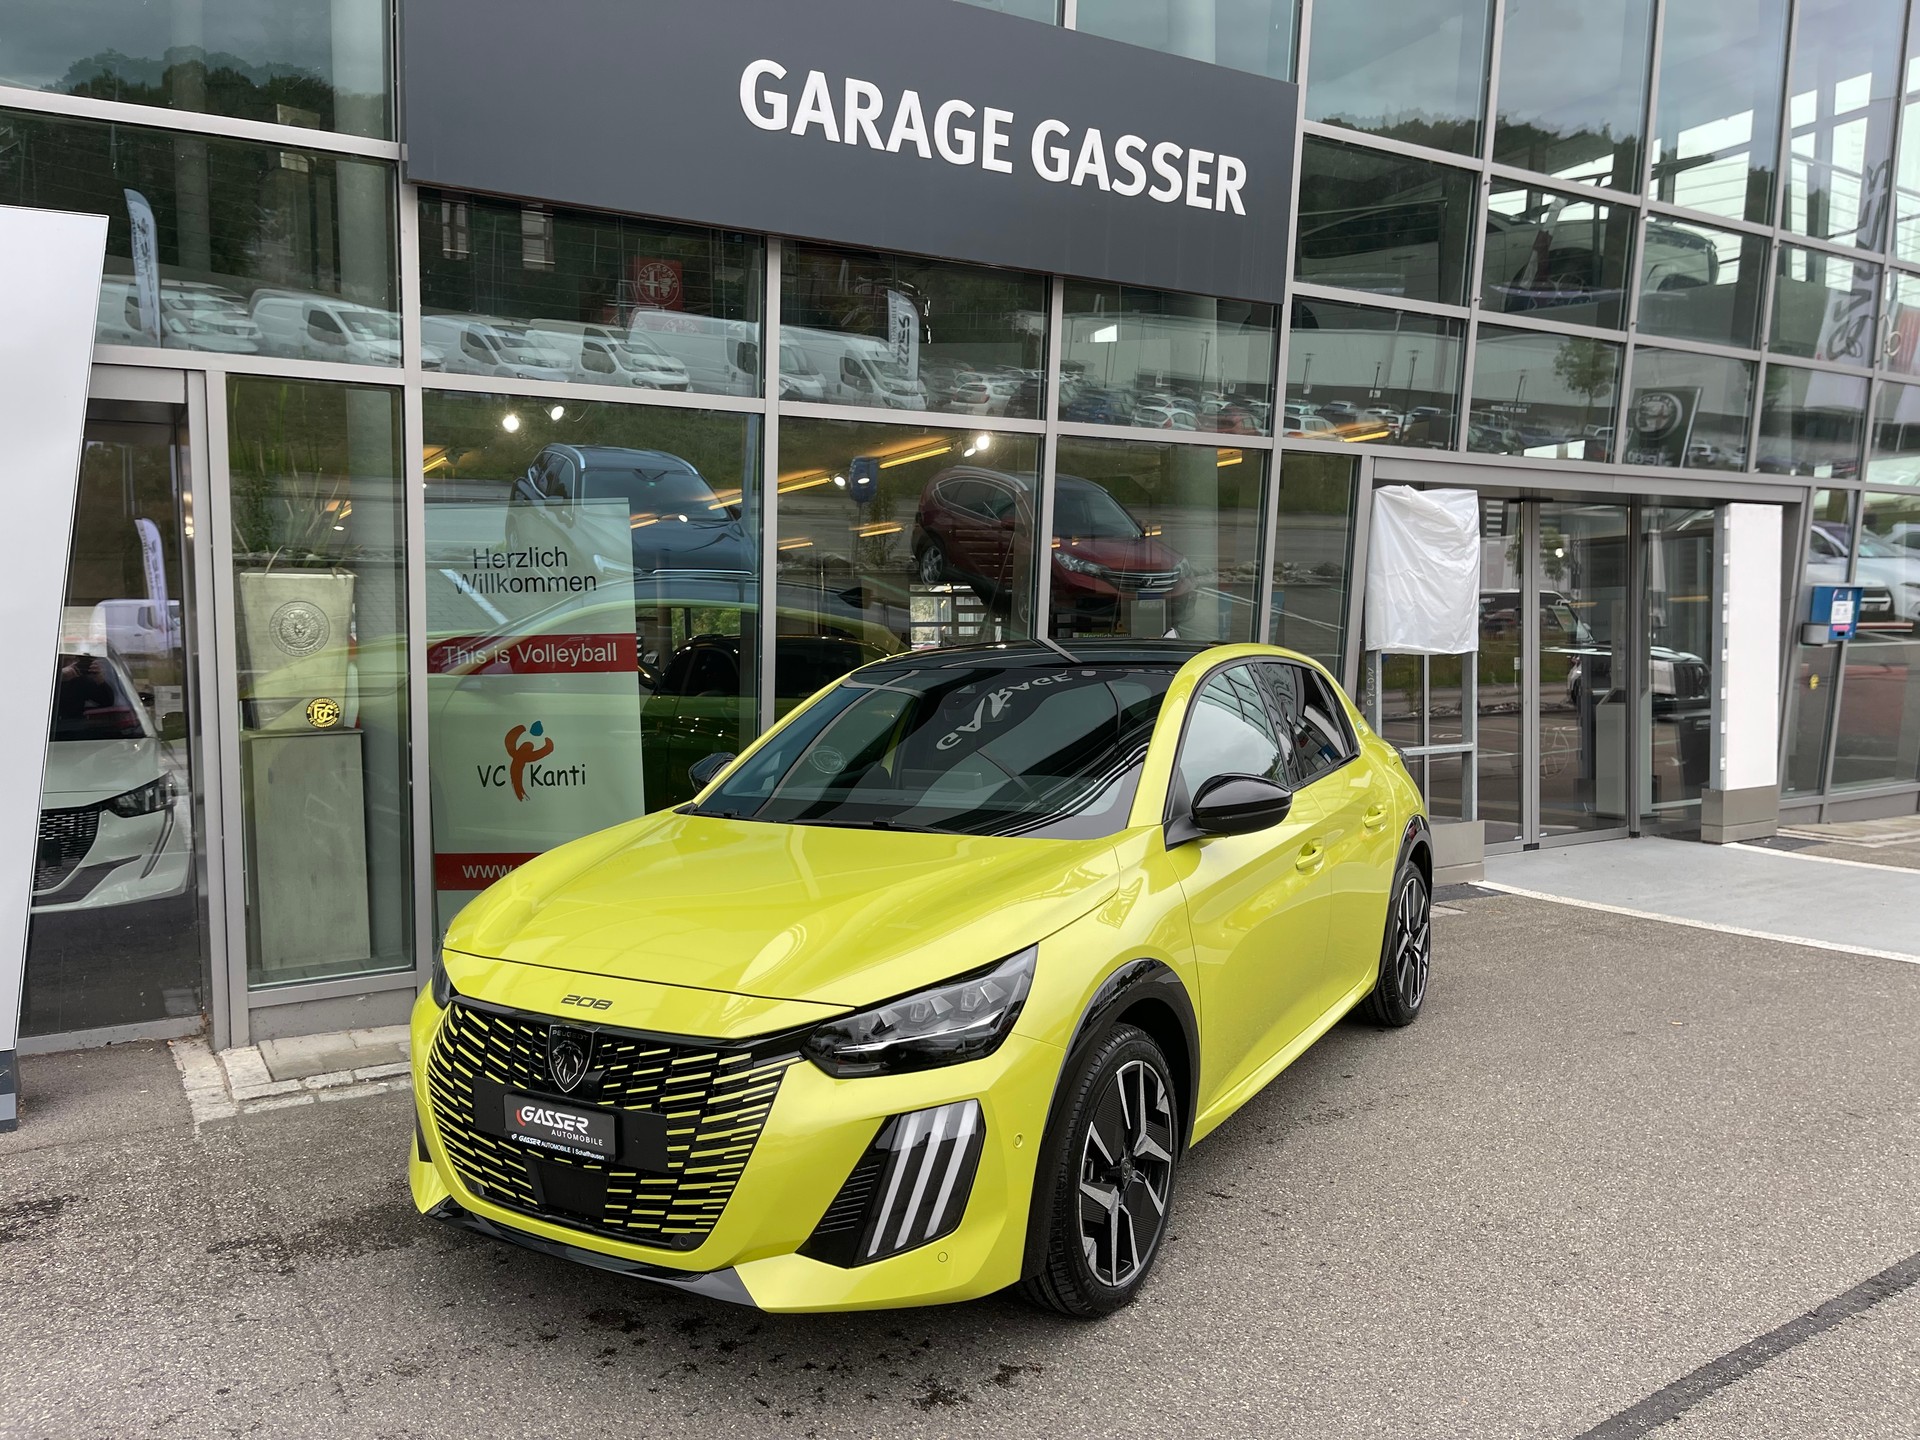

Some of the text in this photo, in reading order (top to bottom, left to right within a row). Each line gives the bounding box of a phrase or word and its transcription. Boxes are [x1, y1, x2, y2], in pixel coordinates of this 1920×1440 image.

[739, 58, 1247, 216] GARAGE GASSER
[473, 546, 568, 569] Herzlich
[455, 573, 597, 595] Willkommen
[442, 642, 617, 667] This is Volleyball
[477, 763, 586, 787] VC Kanti
[561, 994, 613, 1010] 208
[552, 1029, 589, 1040] PEUGEOT
[521, 1106, 588, 1134] GASSER
[519, 1135, 541, 1146] GASSER
[541, 1140, 571, 1153] AUTOMOBILE
[575, 1149, 605, 1160] Schaffhausen
[551, 1129, 603, 1146] AUTOMOBILE
